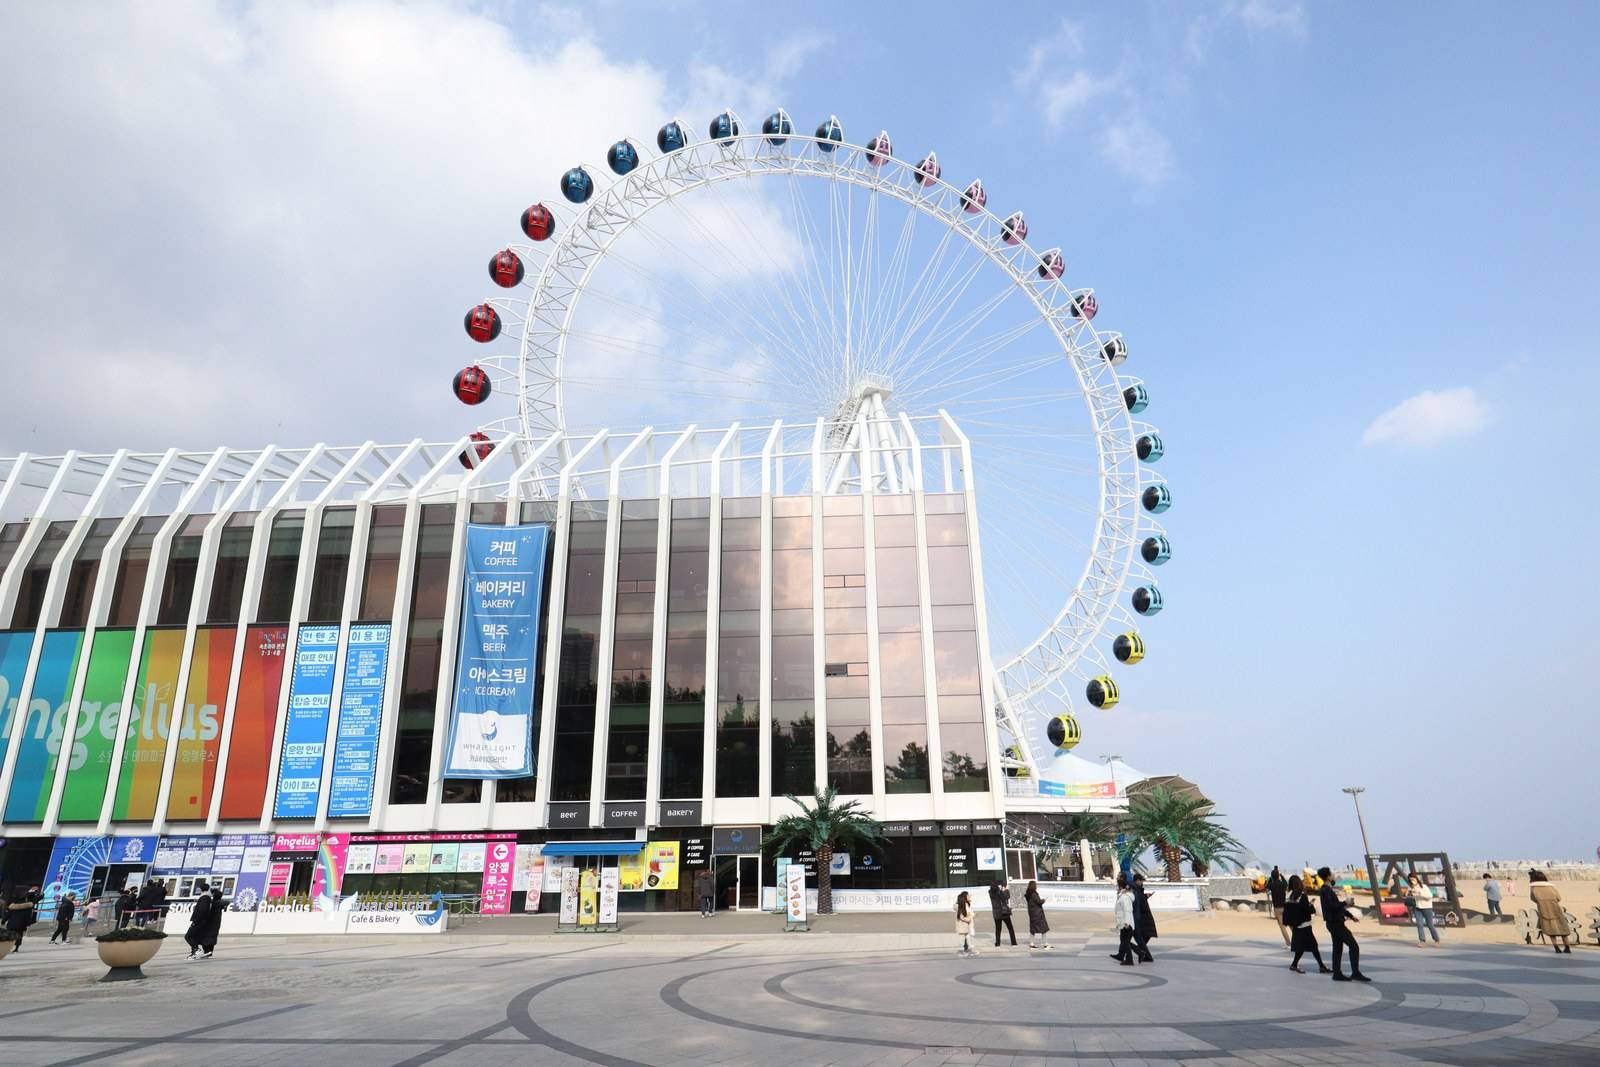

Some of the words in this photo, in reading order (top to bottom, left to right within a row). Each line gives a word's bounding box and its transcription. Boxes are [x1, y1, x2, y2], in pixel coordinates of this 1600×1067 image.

[490, 540, 517, 556] 커피
[484, 557, 518, 566] COFFEE
[475, 580, 526, 597] 베이커리
[482, 600, 515, 609] BAKERY
[483, 624, 510, 640] 맥주
[483, 642, 507, 652] BEER
[276, 835, 316, 849] Angelus
[351, 915, 367, 923] Cafe
[369, 915, 374, 923] &
[375, 914, 400, 924] Bakery
